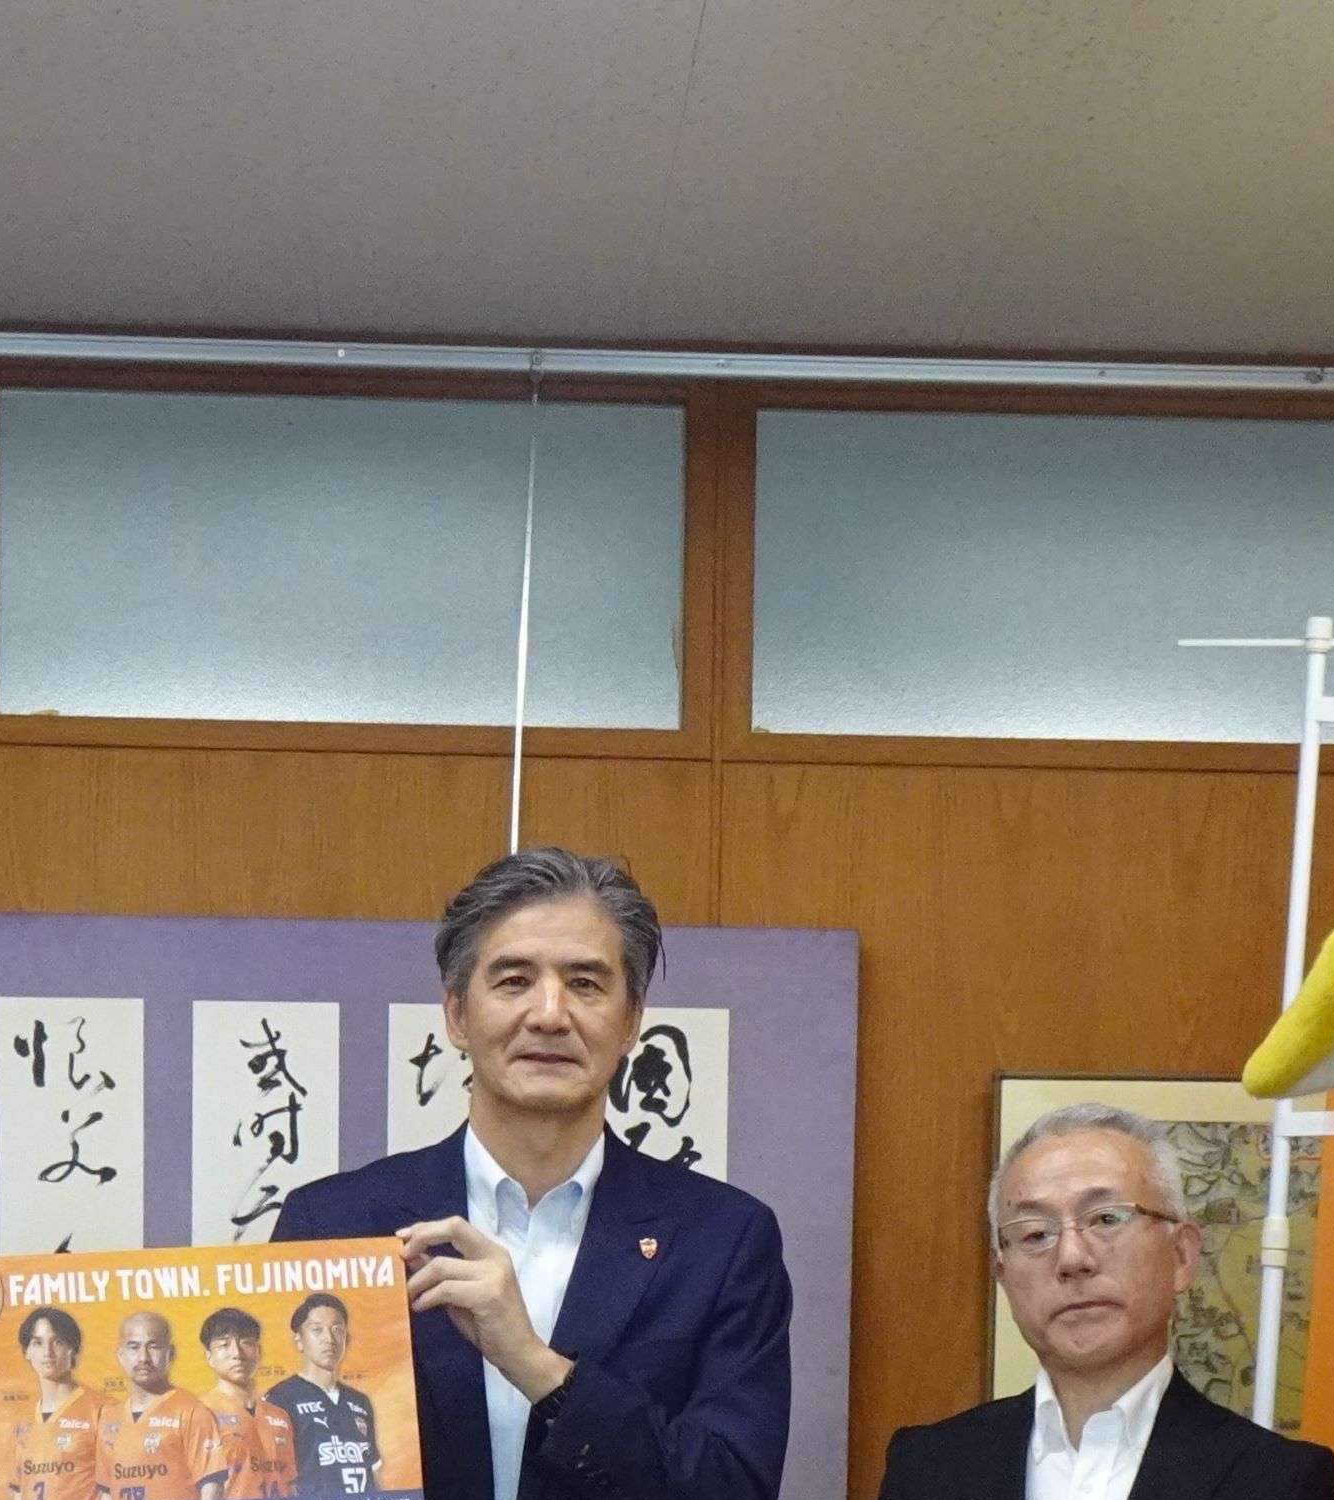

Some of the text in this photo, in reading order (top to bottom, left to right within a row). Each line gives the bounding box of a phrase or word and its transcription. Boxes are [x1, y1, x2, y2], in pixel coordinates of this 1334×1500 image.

[8, 1256, 395, 1306] FAMILY TOWN. FUJINOMIYA
[23, 1460, 75, 1475] Suzuyo
[114, 1463, 169, 1480] Suzuyo
[341, 1467, 367, 1494] 57
